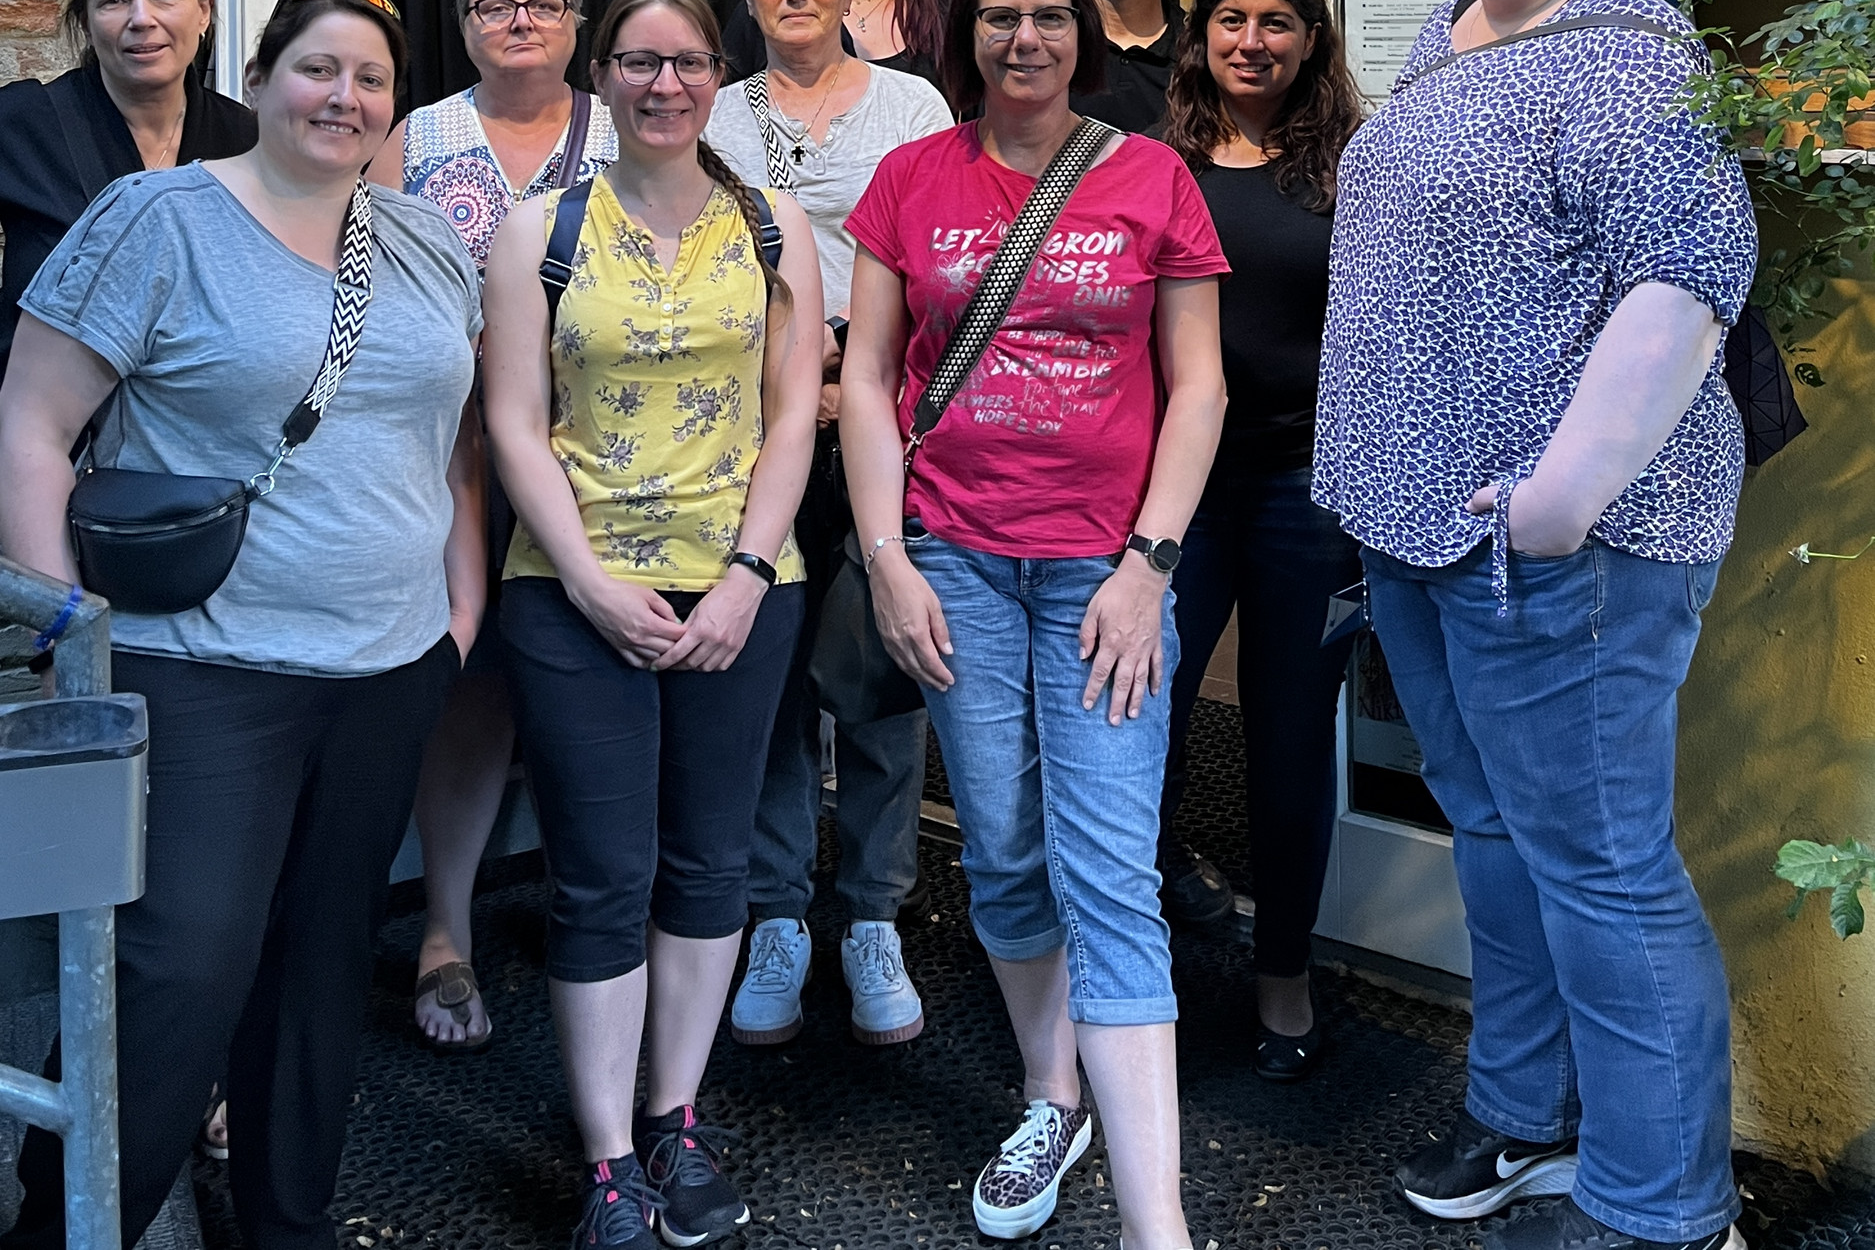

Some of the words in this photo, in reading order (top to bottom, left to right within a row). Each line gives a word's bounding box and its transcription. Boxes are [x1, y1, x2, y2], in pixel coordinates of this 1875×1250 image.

[930, 227, 982, 250] LET
[1043, 231, 1131, 256] GROW
[1035, 260, 1110, 284] VIBES
